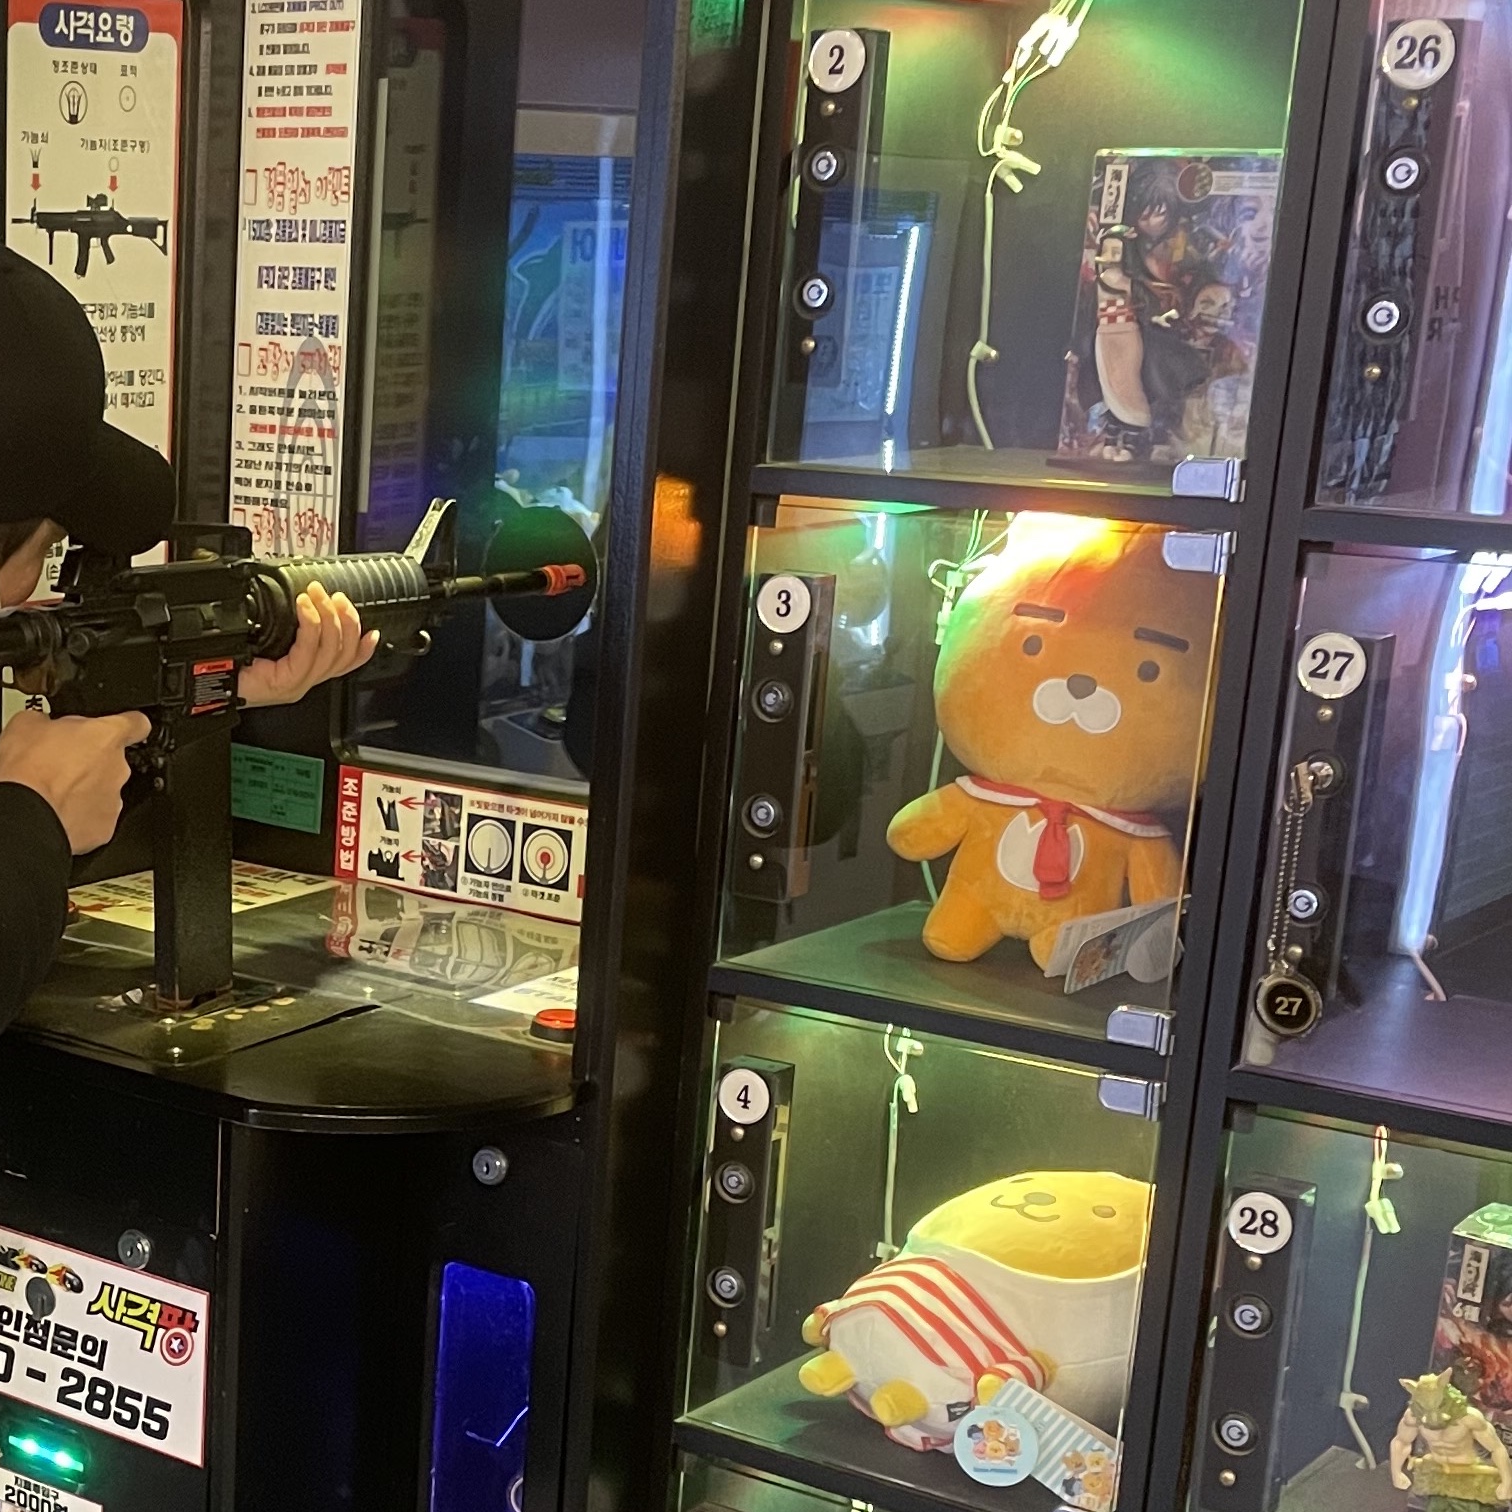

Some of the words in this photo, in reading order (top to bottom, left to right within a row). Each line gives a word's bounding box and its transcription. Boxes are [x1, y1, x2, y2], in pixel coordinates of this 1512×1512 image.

[55, 10, 134, 46] 사격요령
[828, 45, 844, 76] 2
[1394, 34, 1442, 70] 26
[775, 589, 792, 618] 3
[1309, 649, 1356, 682] 27
[1274, 997, 1303, 1017] 27
[736, 1084, 752, 1110] 4
[1239, 1208, 1281, 1238] 28
